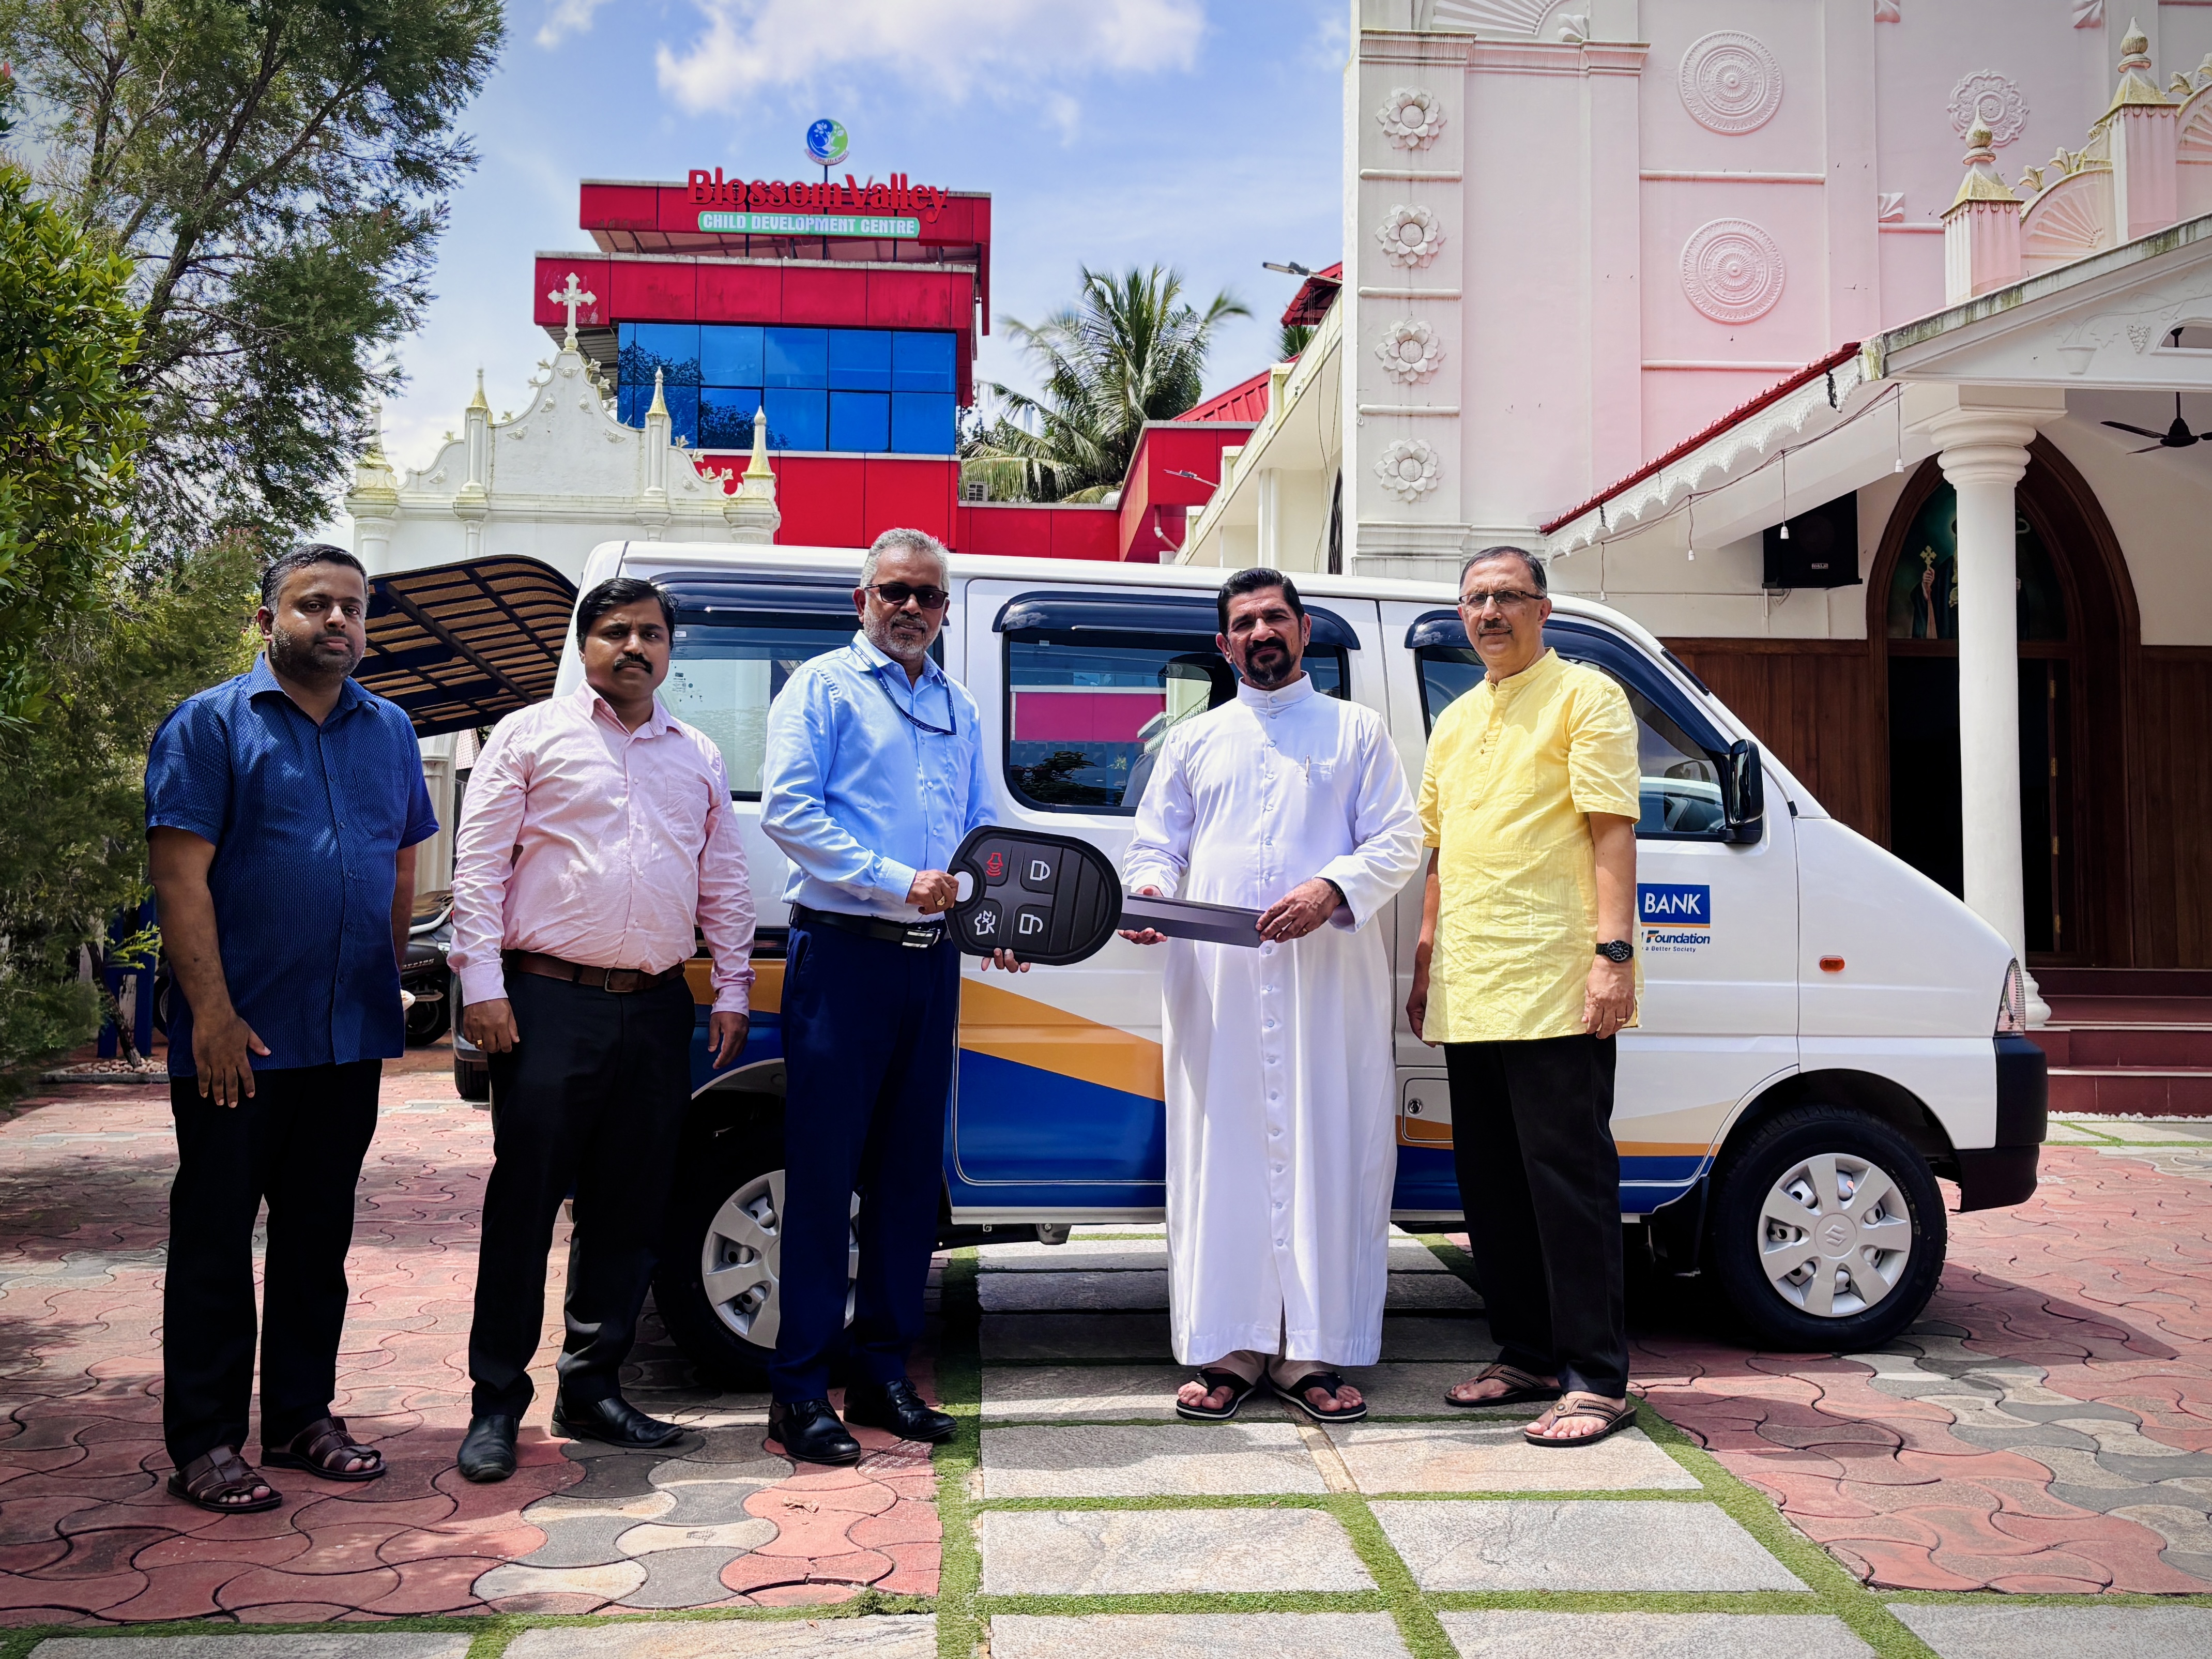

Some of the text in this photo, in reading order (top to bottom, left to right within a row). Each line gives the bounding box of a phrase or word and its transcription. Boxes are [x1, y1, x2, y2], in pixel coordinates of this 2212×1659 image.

[688, 167, 949, 223] Blossom Valley
[703, 214, 914, 234] CHILD DEVELOPMENT CENTRE
[1644, 892, 1701, 915] BANK
[1646, 930, 1711, 944] Foundation
